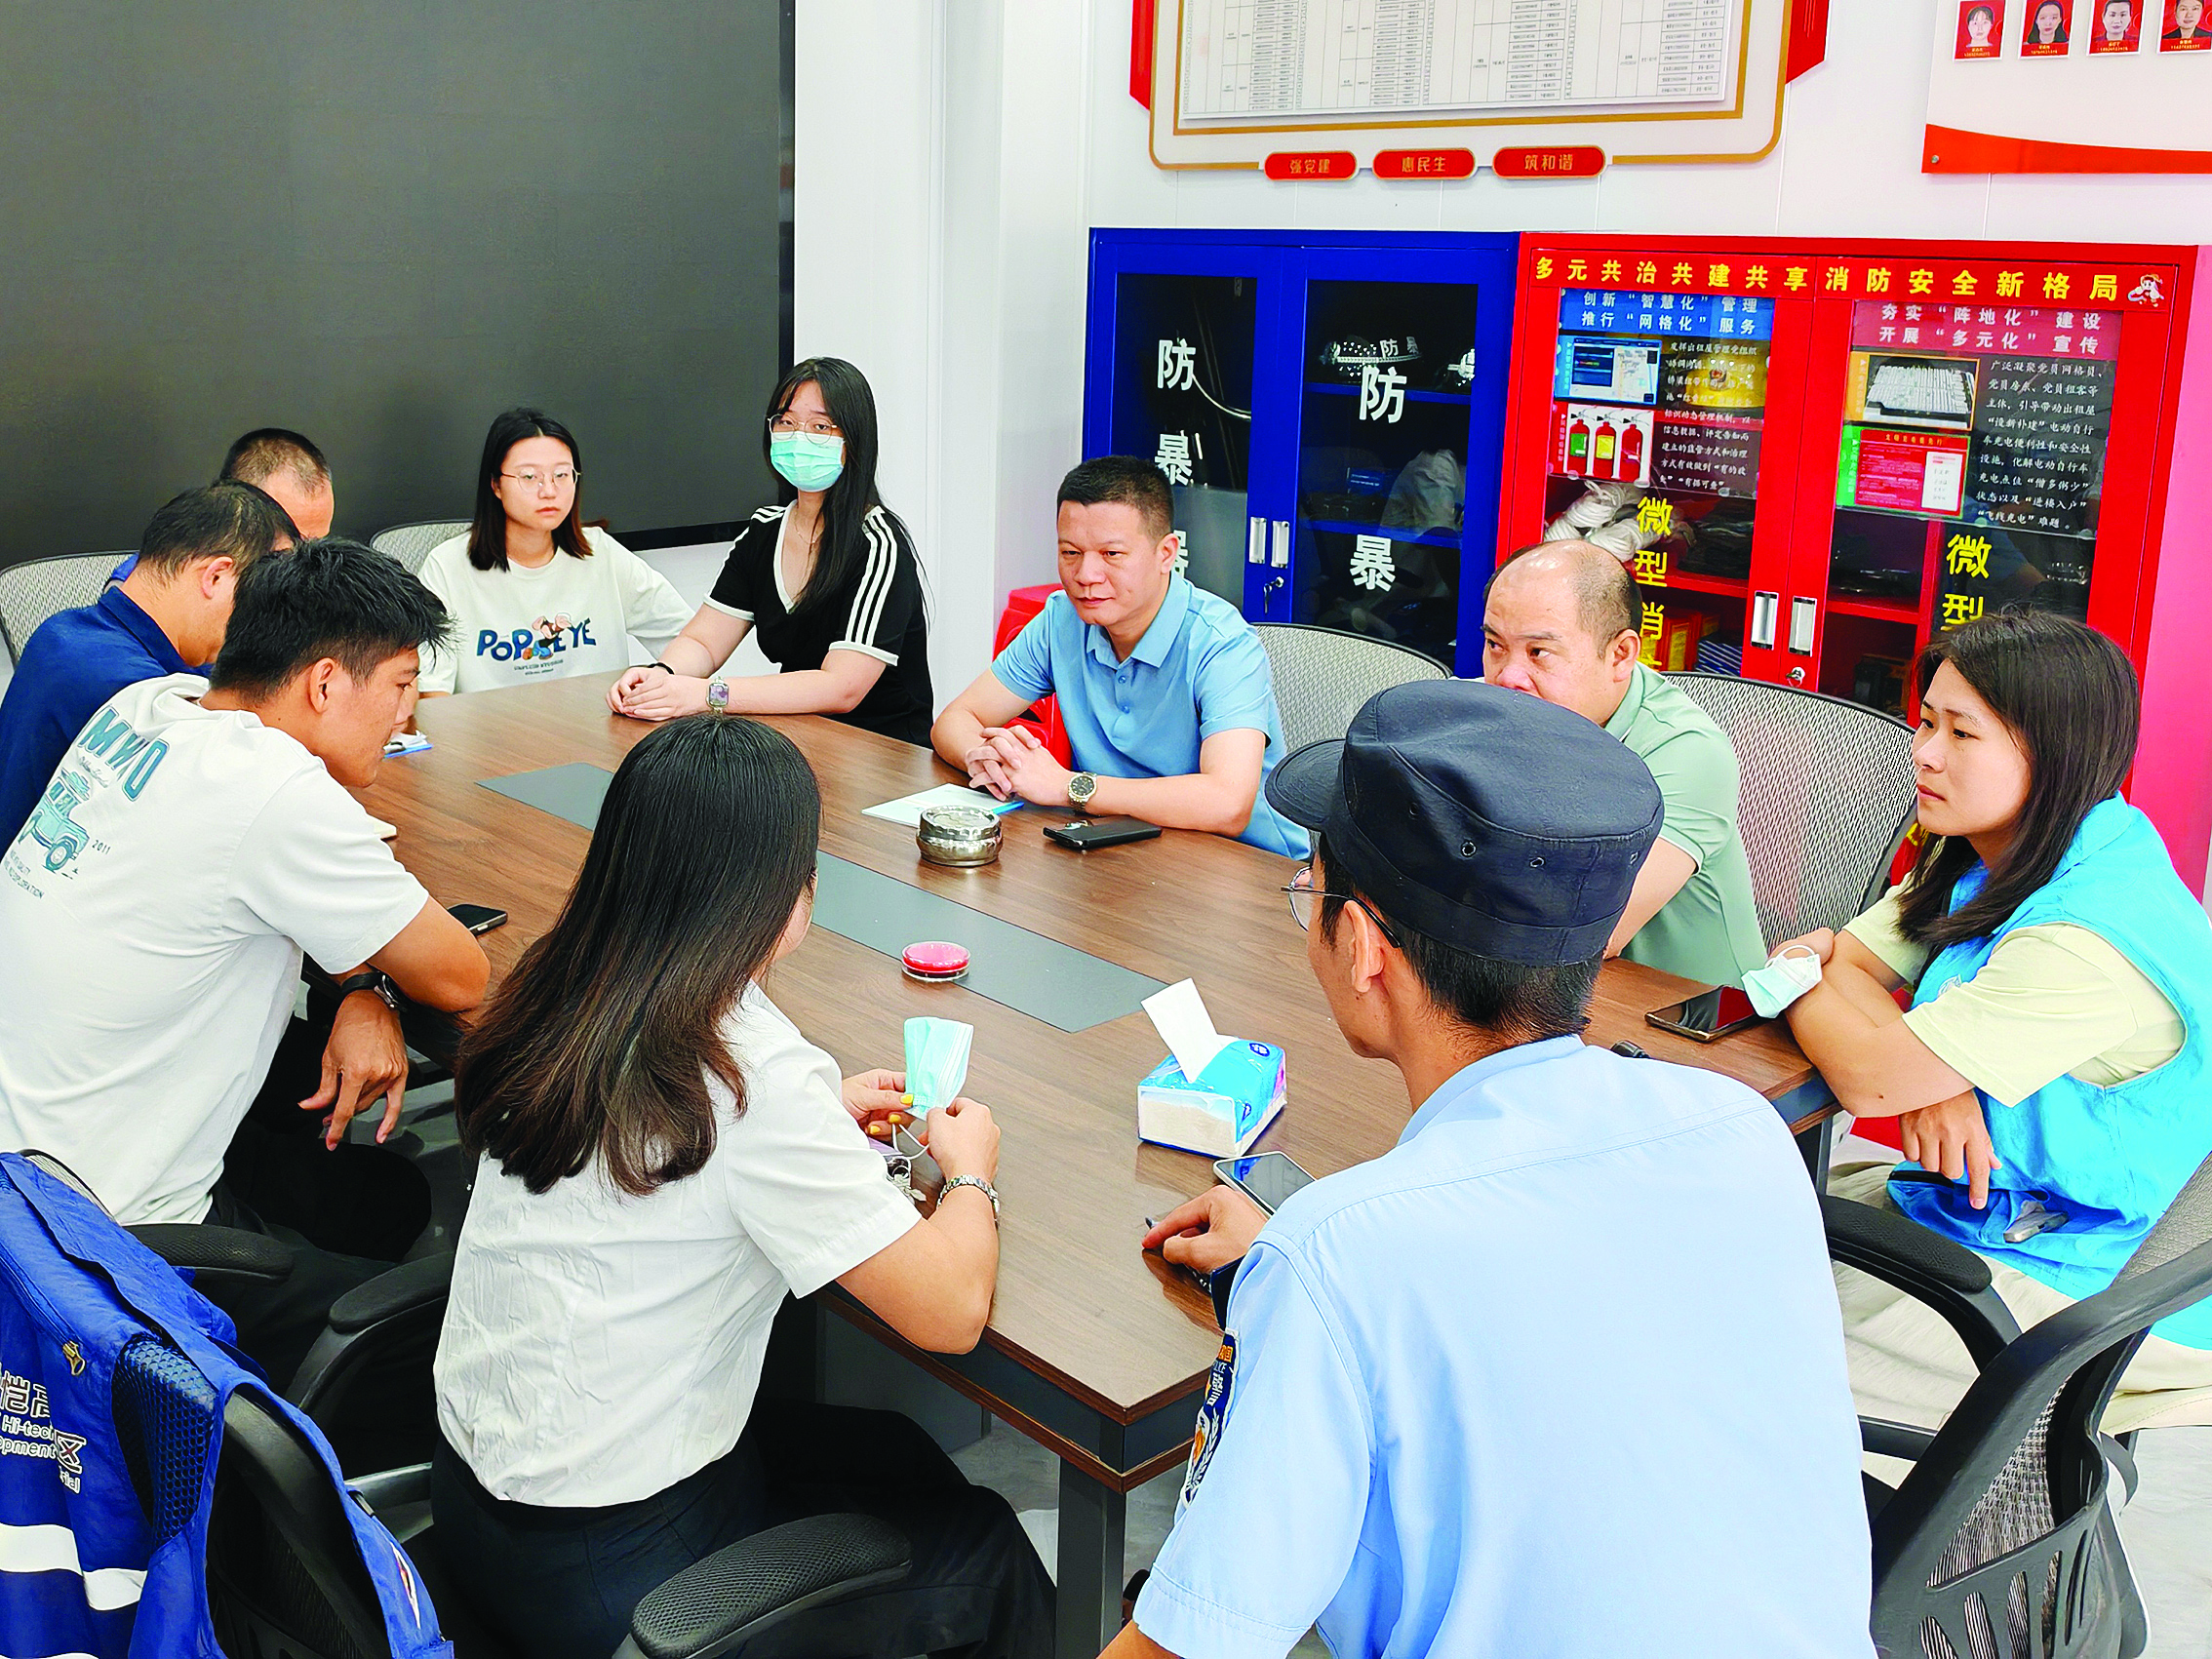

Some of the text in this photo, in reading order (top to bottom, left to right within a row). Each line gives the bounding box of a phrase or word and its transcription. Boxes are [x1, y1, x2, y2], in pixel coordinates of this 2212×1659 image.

[1401, 156, 1447, 174] 惠民生
[1524, 153, 1574, 173] 筑和谐
[92, 839, 111, 854] 2011
